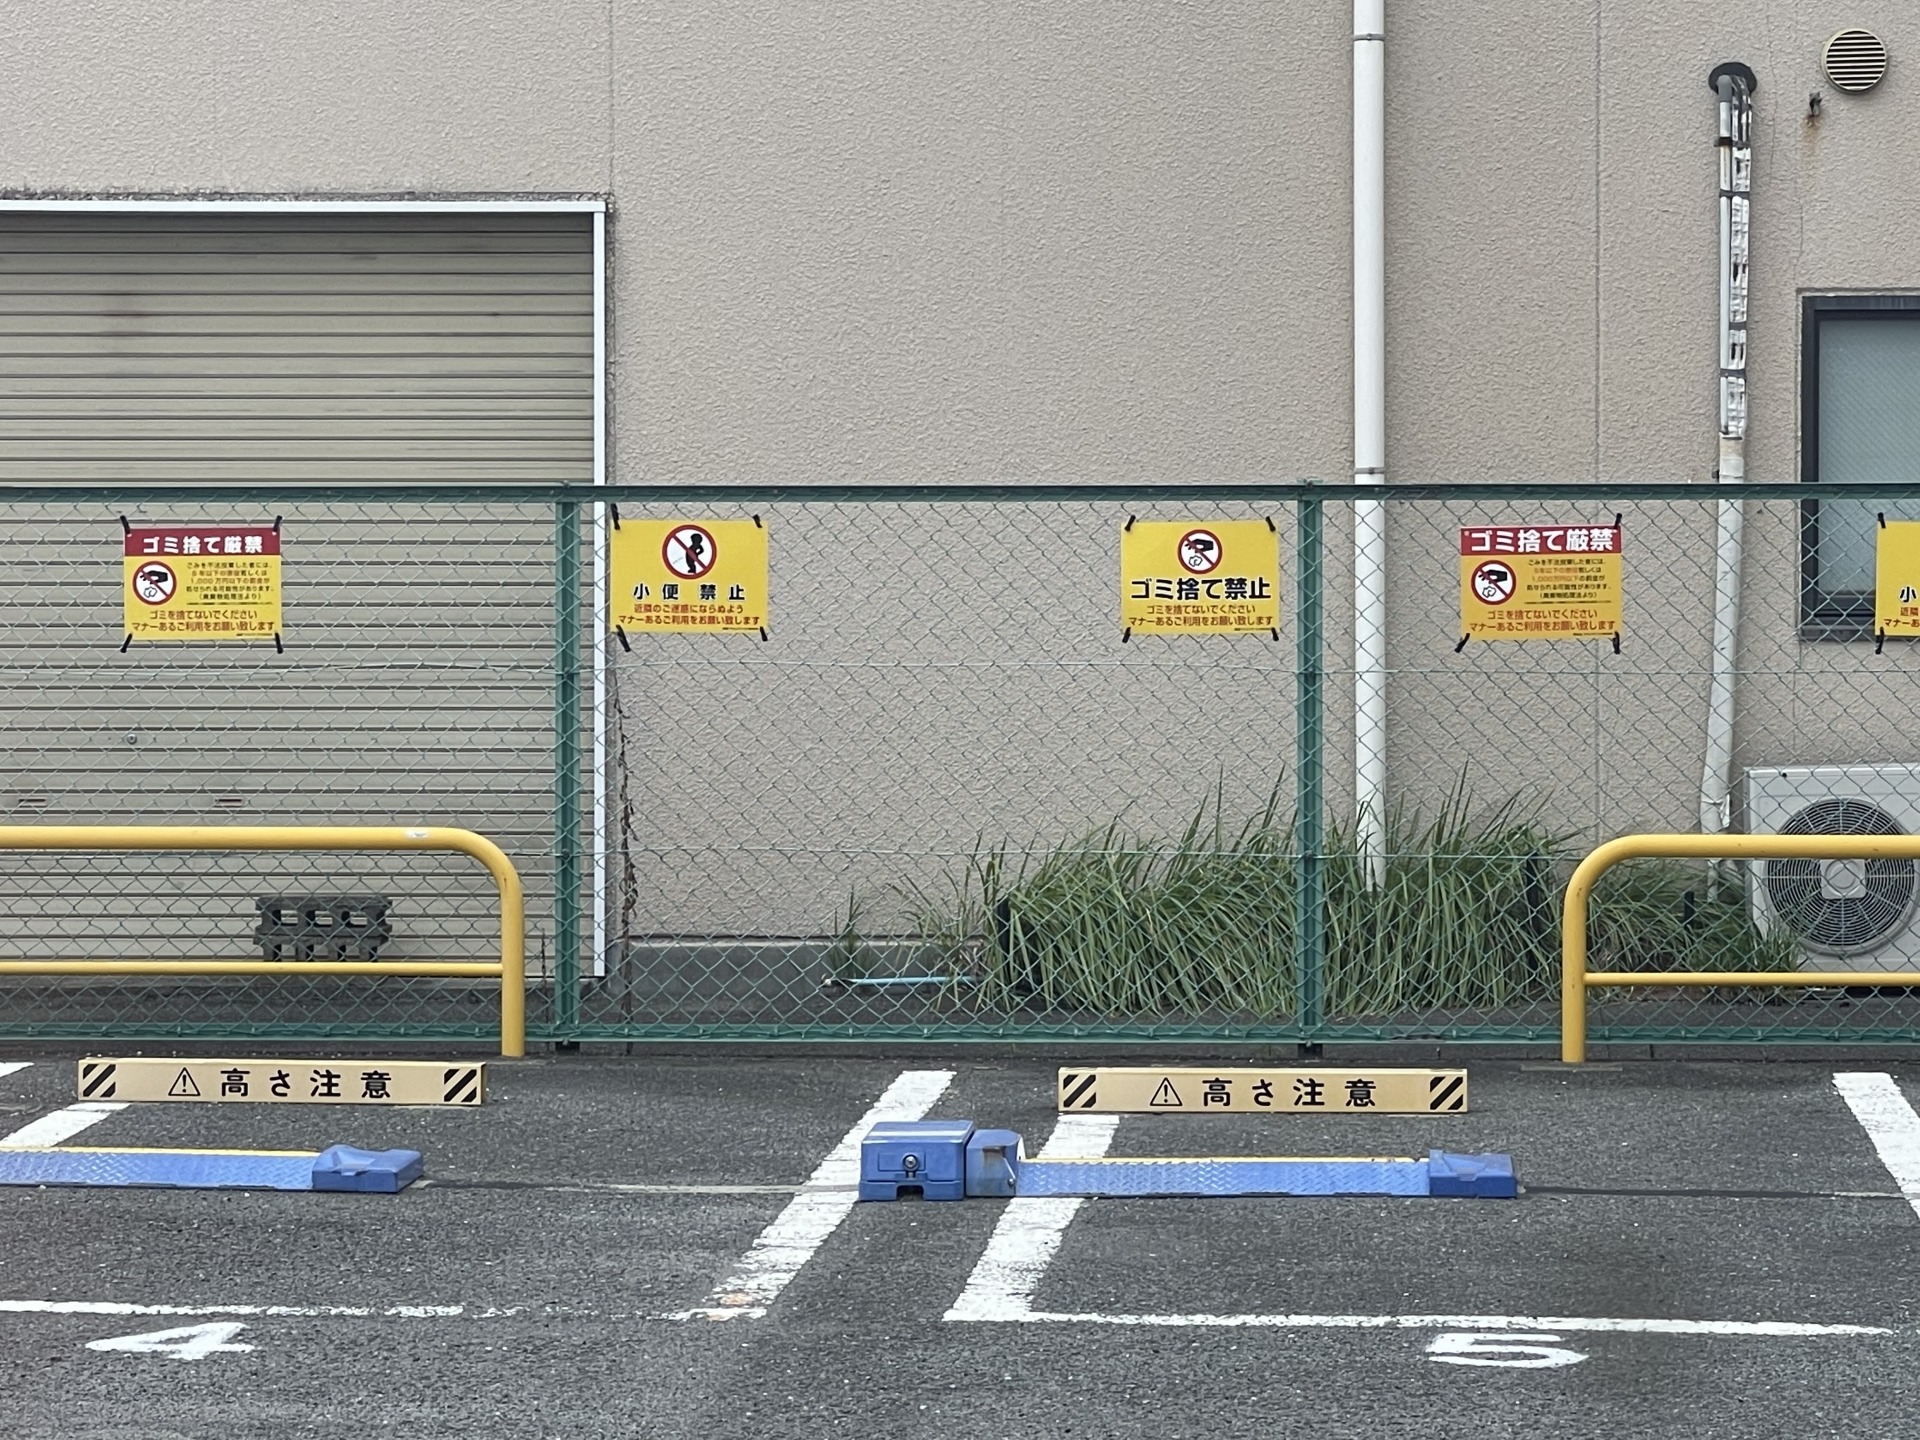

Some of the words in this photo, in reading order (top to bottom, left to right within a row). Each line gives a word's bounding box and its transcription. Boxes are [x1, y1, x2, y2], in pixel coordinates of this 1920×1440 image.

[143, 535, 263, 554] ゴミ捨て厳禁
[1471, 528, 1614, 552] ゴミ捨て厳禁
[633, 583, 745, 600] 小便禁止
[1131, 577, 1271, 600] ゴミ捨て禁止
[1900, 586, 1917, 603] 小
[150, 610, 257, 620] ゴミを捨てないでください
[634, 604, 744, 613] 近隣のご迷惑にならぬよう
[1147, 605, 1256, 614] ゴミを捨てないでください
[1487, 609, 1597, 620] ゴミを捨てないでください
[132, 621, 275, 631] マナーあるご利用をお願い致します
[618, 615, 760, 625] マナーあるご利用をお願い致します
[1129, 616, 1273, 626] マナーあるご利用をお願い致します
[1469, 620, 1615, 632] マナーあるご利用をお願い致します
[220, 1069, 393, 1099] 高さ注意
[1201, 1078, 1377, 1107] 高さ注意
[1426, 1332, 1588, 1368] 5
